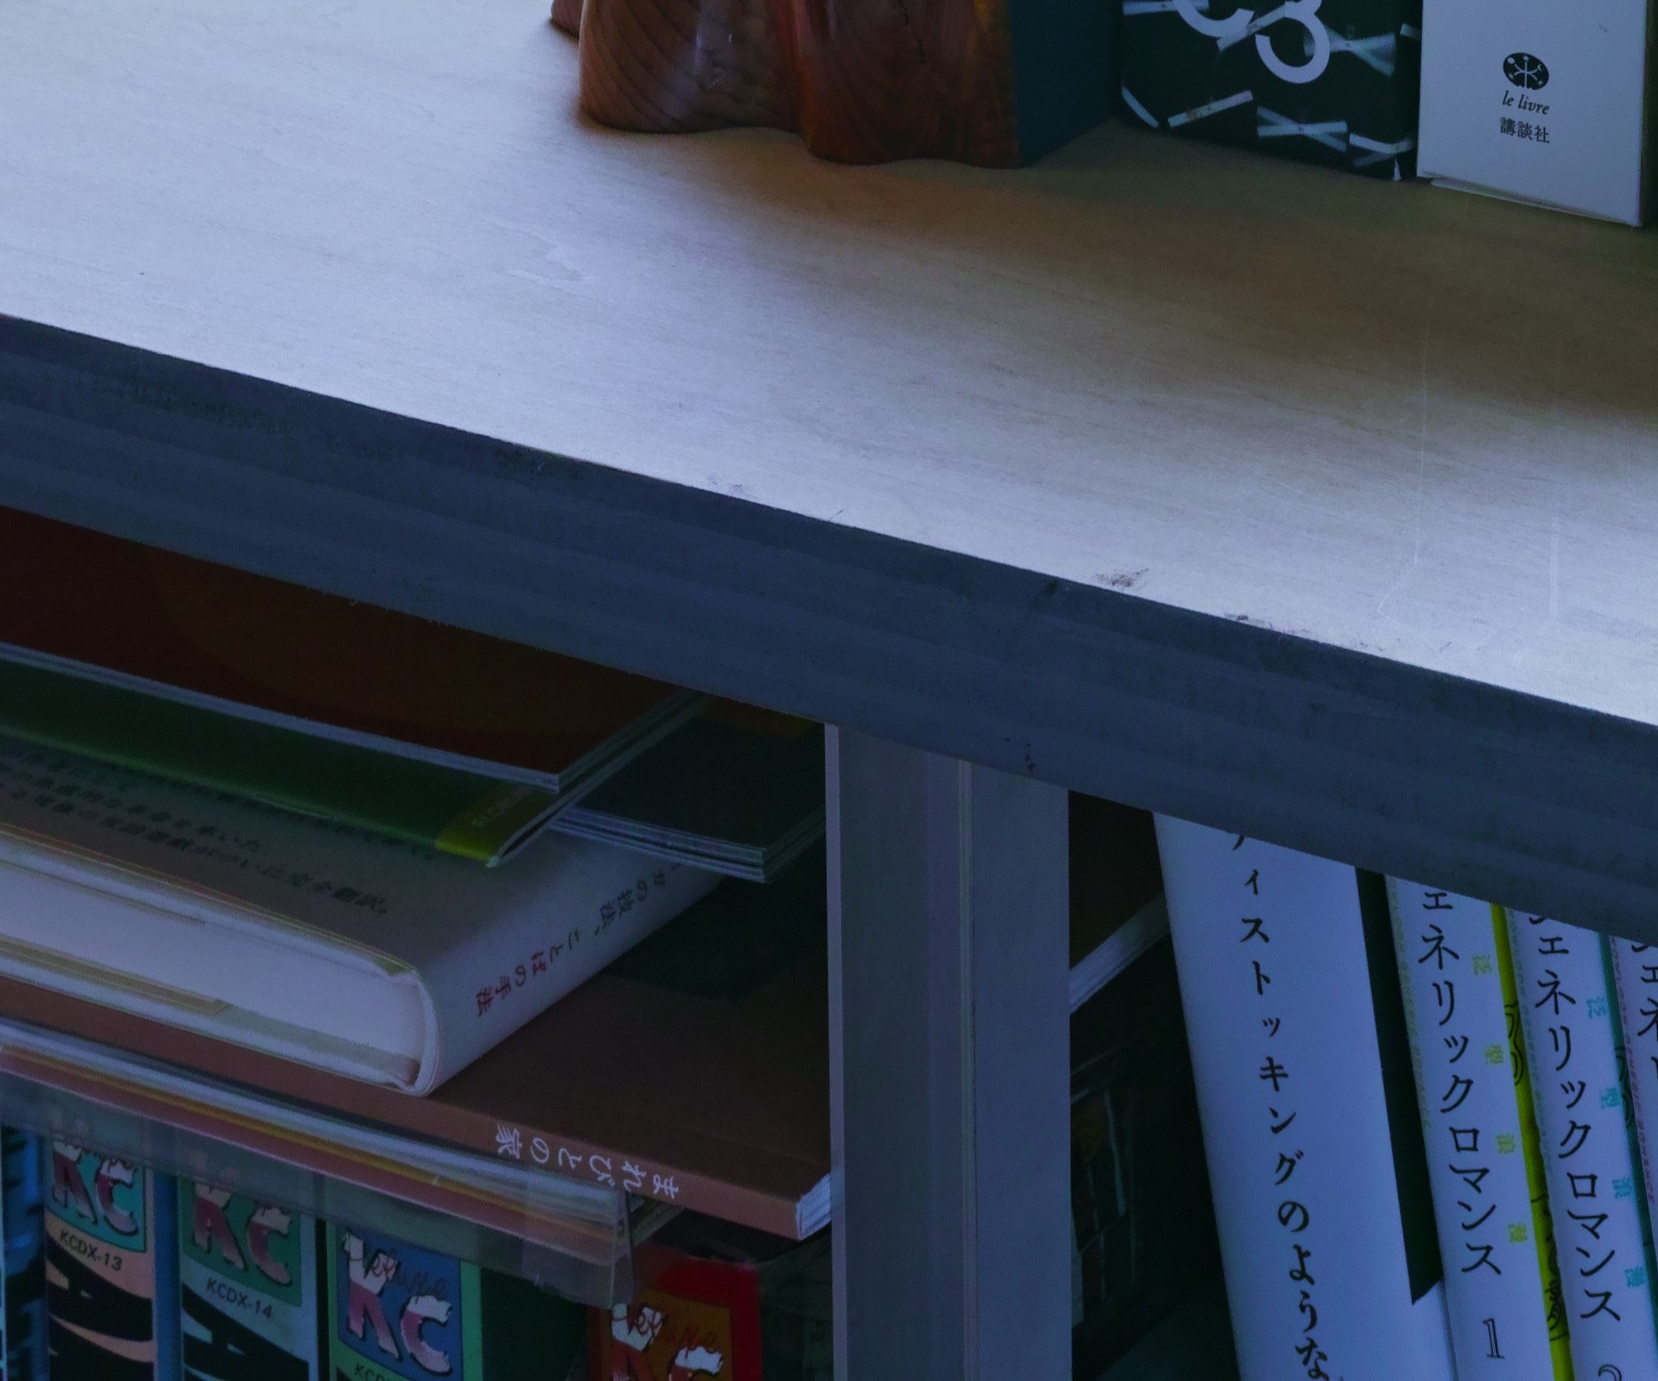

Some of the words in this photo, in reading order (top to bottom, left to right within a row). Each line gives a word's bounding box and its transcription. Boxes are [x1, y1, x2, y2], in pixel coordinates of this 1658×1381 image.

[1501, 89, 1514, 107] le
[1517, 93, 1550, 115] livre
[1500, 116, 1550, 144] 講談社
[1232, 835, 1334, 1381] ィストッキングのような
[1529, 917, 1621, 1322] ェネリックロマンス
[495, 1122, 680, 1200] まれびとの家
[60, 1228, 123, 1272] KCDX-13
[206, 1277, 273, 1320] KCDX-14
